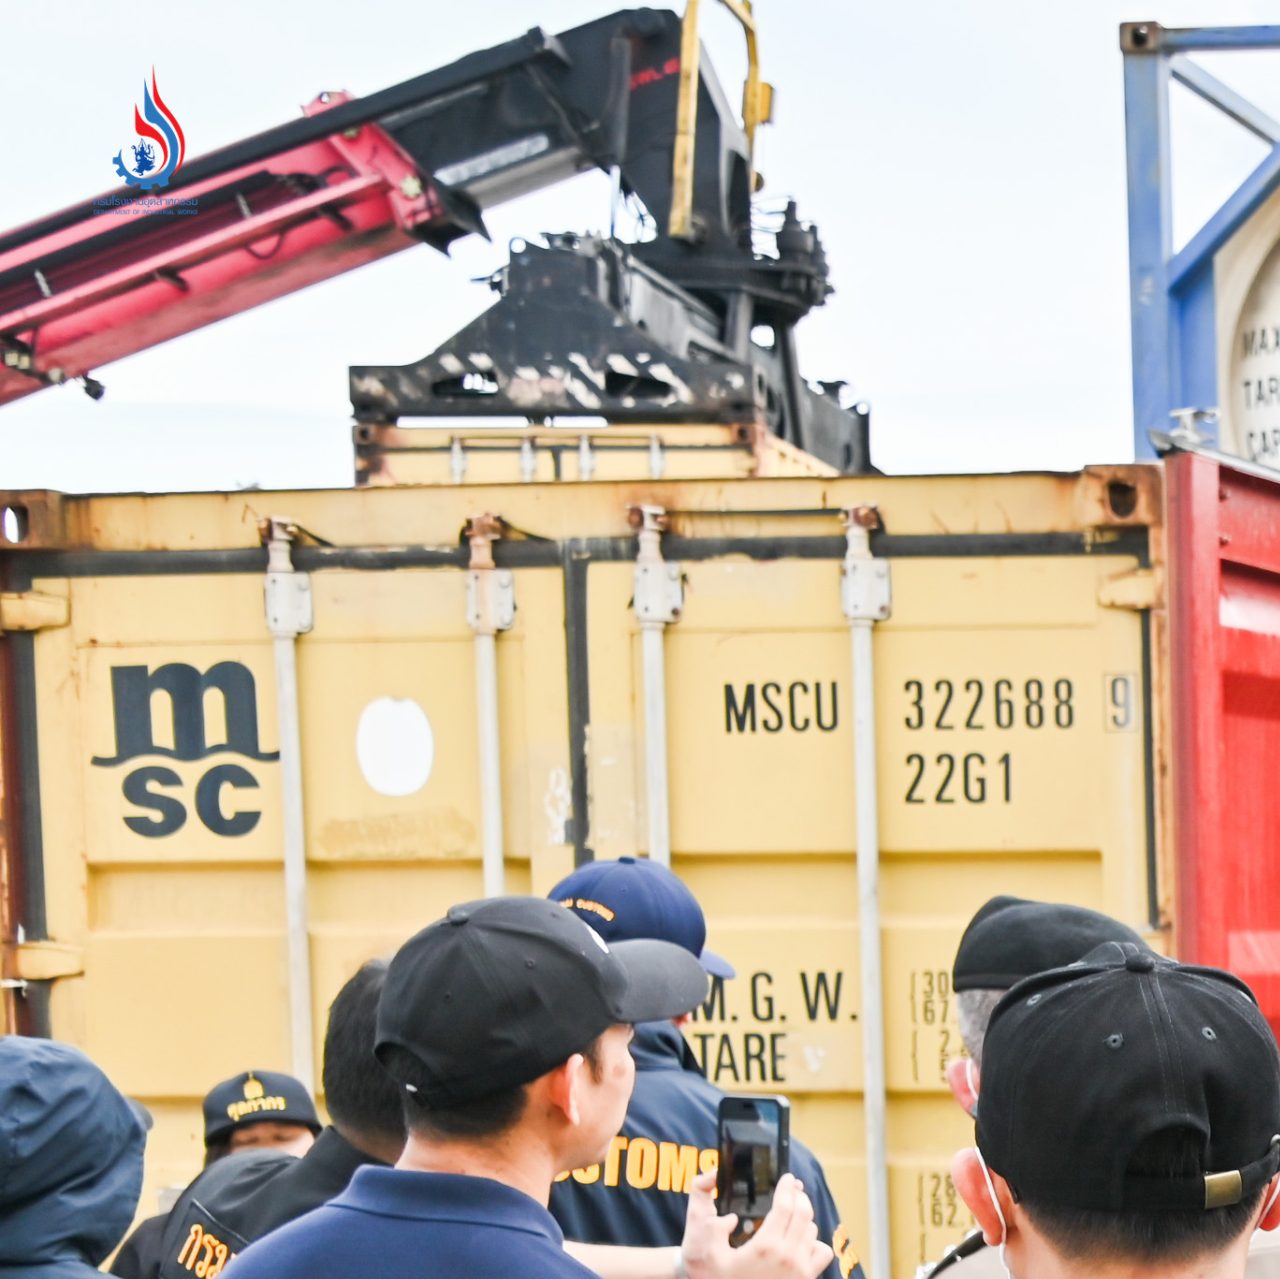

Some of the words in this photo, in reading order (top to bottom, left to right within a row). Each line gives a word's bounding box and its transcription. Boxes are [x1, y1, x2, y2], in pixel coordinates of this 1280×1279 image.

[724, 681, 839, 733] MSCU
[904, 678, 1075, 732] 322688
[1111, 676, 1132, 728] 9
[904, 752, 1013, 804] 22G1
[693, 1033, 787, 1083] TARE
